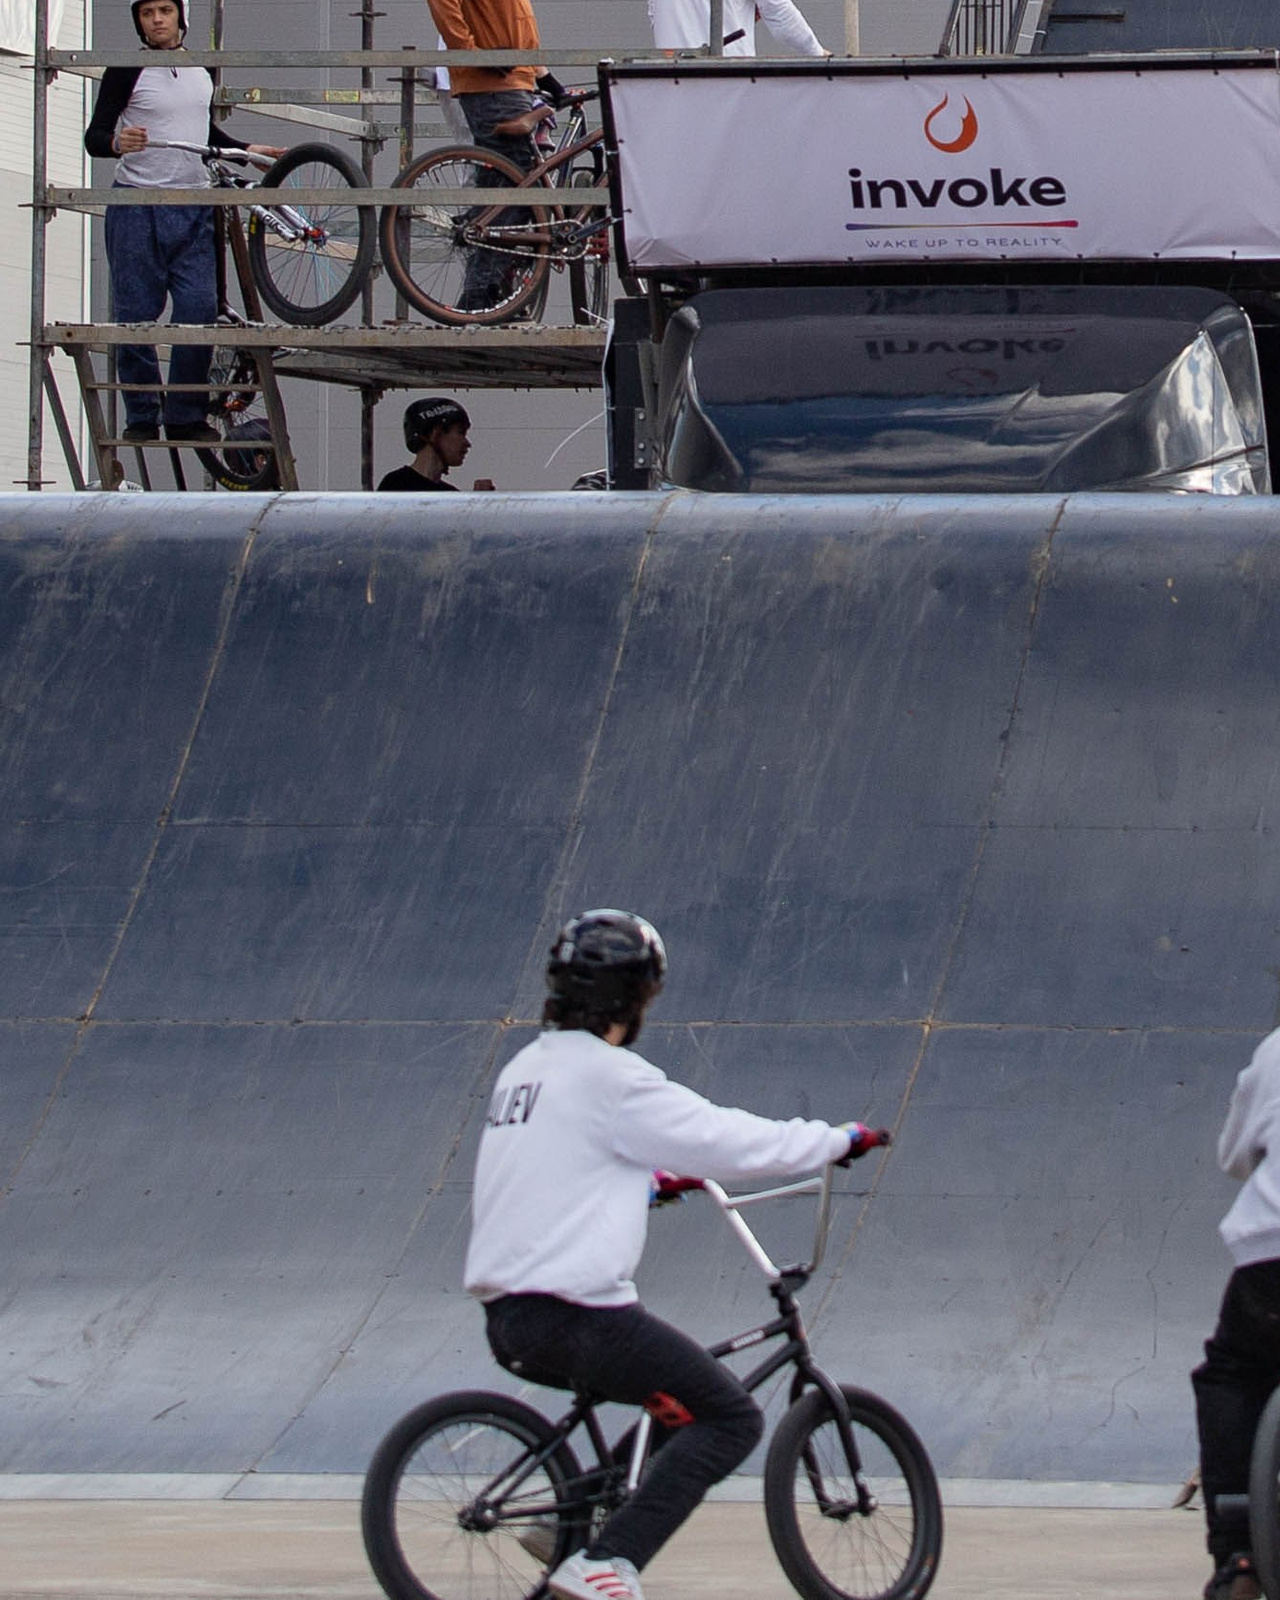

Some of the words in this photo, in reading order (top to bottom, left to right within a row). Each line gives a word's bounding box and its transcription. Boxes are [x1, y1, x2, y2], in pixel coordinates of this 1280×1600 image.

[848, 168, 1066, 209] invoke
[865, 238, 919, 248] WAKE
[925, 238, 949, 248] UP
[956, 238, 979, 248] TO
[986, 237, 1063, 247] REALITY
